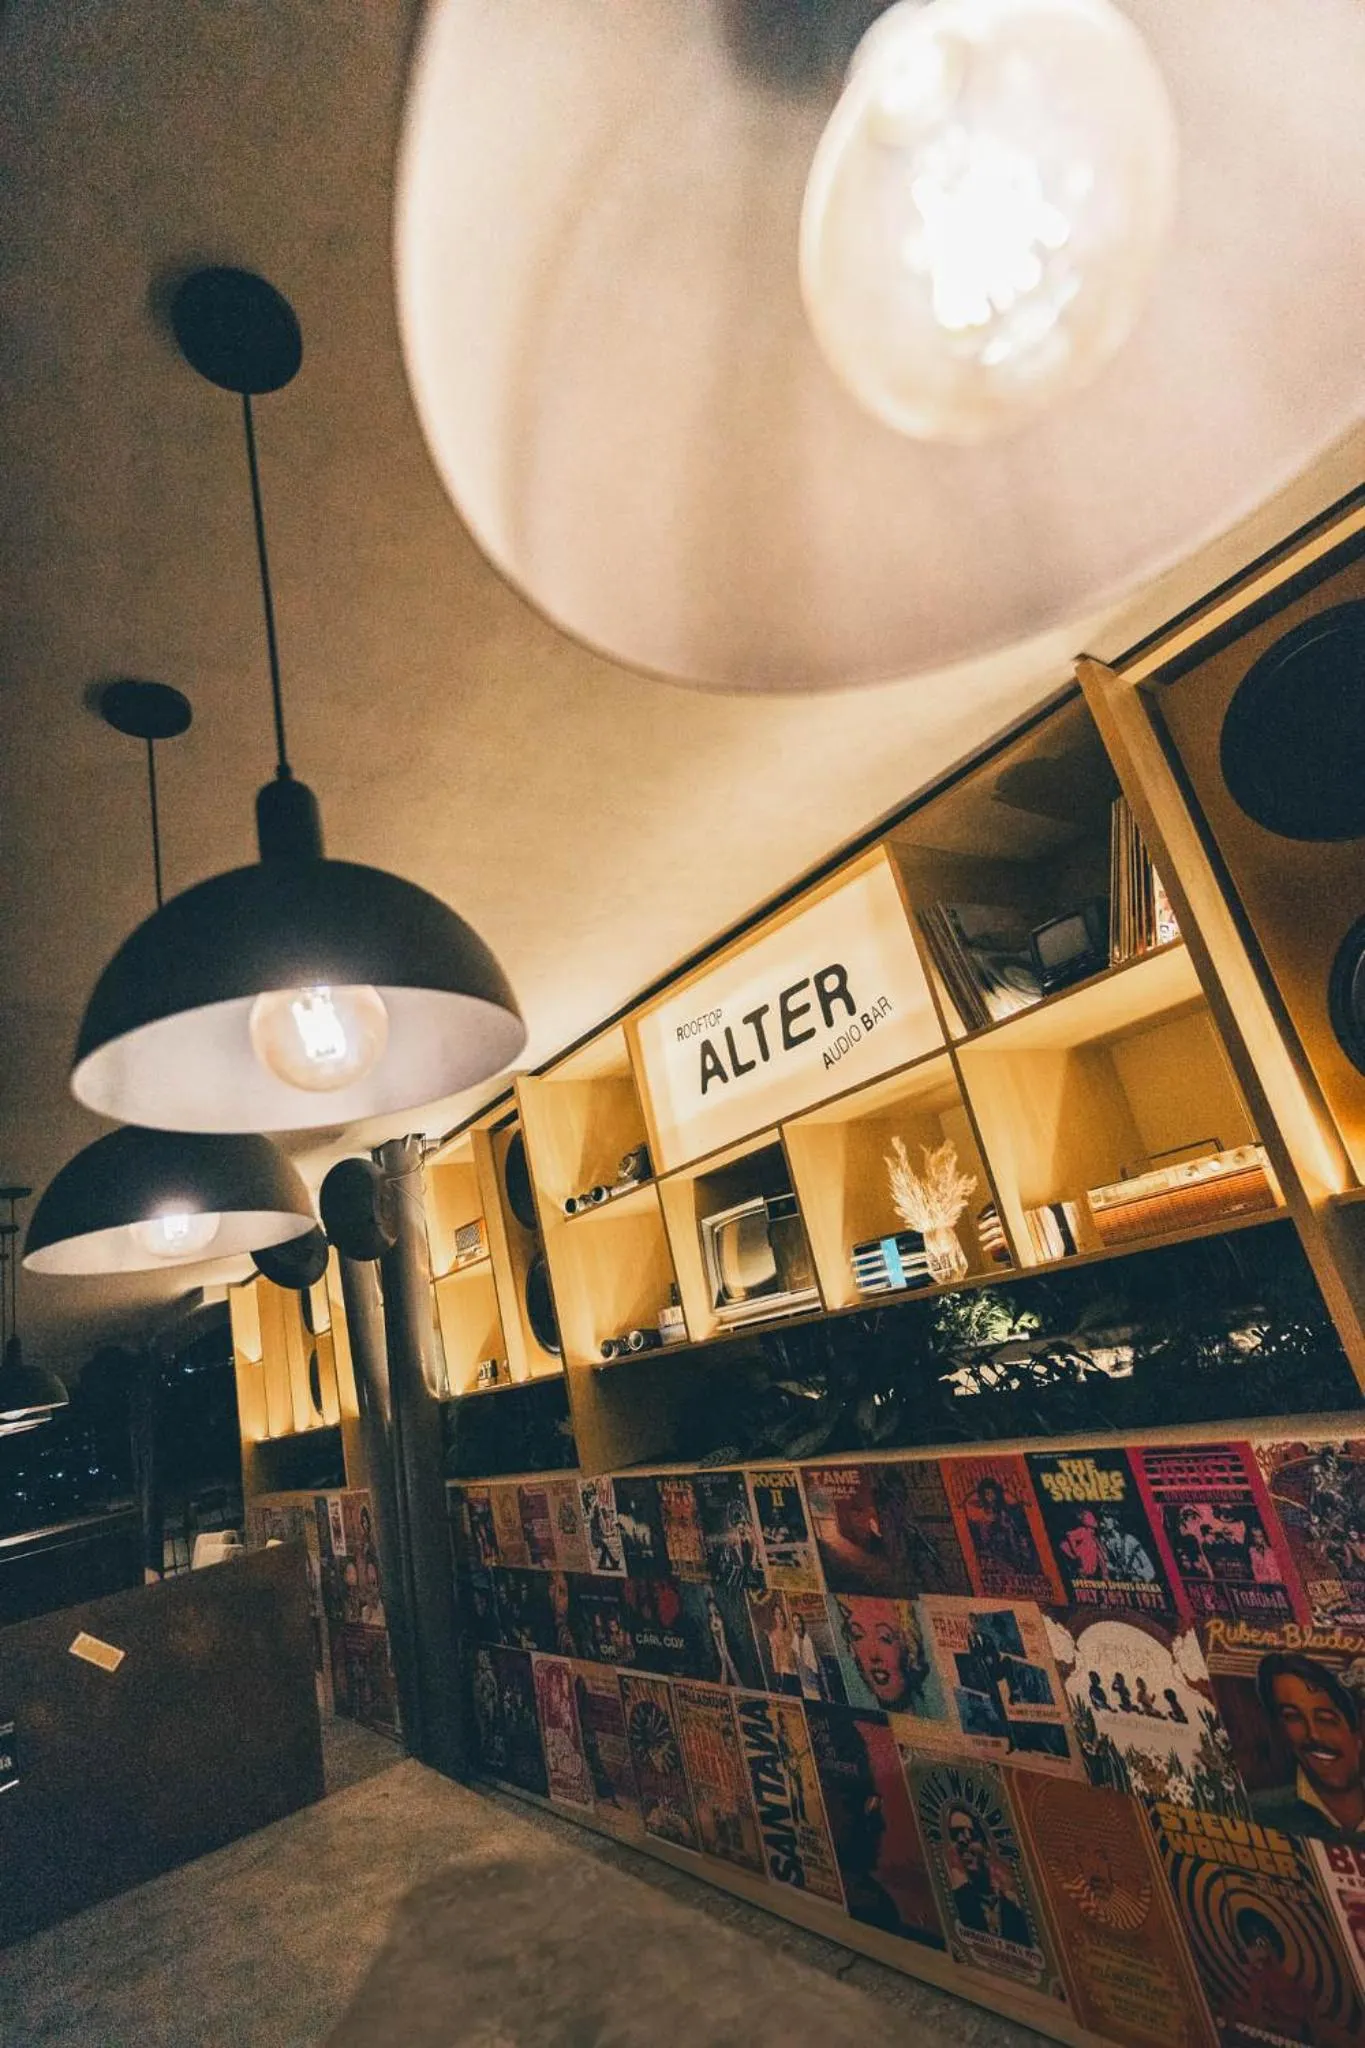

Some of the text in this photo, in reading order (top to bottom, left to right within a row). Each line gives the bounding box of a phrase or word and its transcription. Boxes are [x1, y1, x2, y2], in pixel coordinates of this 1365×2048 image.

[676, 1007, 723, 1042] ROOFTOP
[700, 963, 857, 1095] ALTER
[822, 995, 894, 1070] AUDIO BAR
[749, 1473, 798, 1488] ROCKY
[810, 1470, 860, 1485] TAME
[1041, 1469, 1126, 1490] ROLLING
[1057, 1458, 1096, 1472] THE
[769, 1489, 785, 1506] II
[1051, 1486, 1124, 1502] STONES
[1205, 1617, 1279, 1653] Ruben
[738, 1700, 806, 1887] SANTANA
[1156, 1802, 1292, 1854] STEVIE
[1166, 1829, 1302, 1881] WONDER
